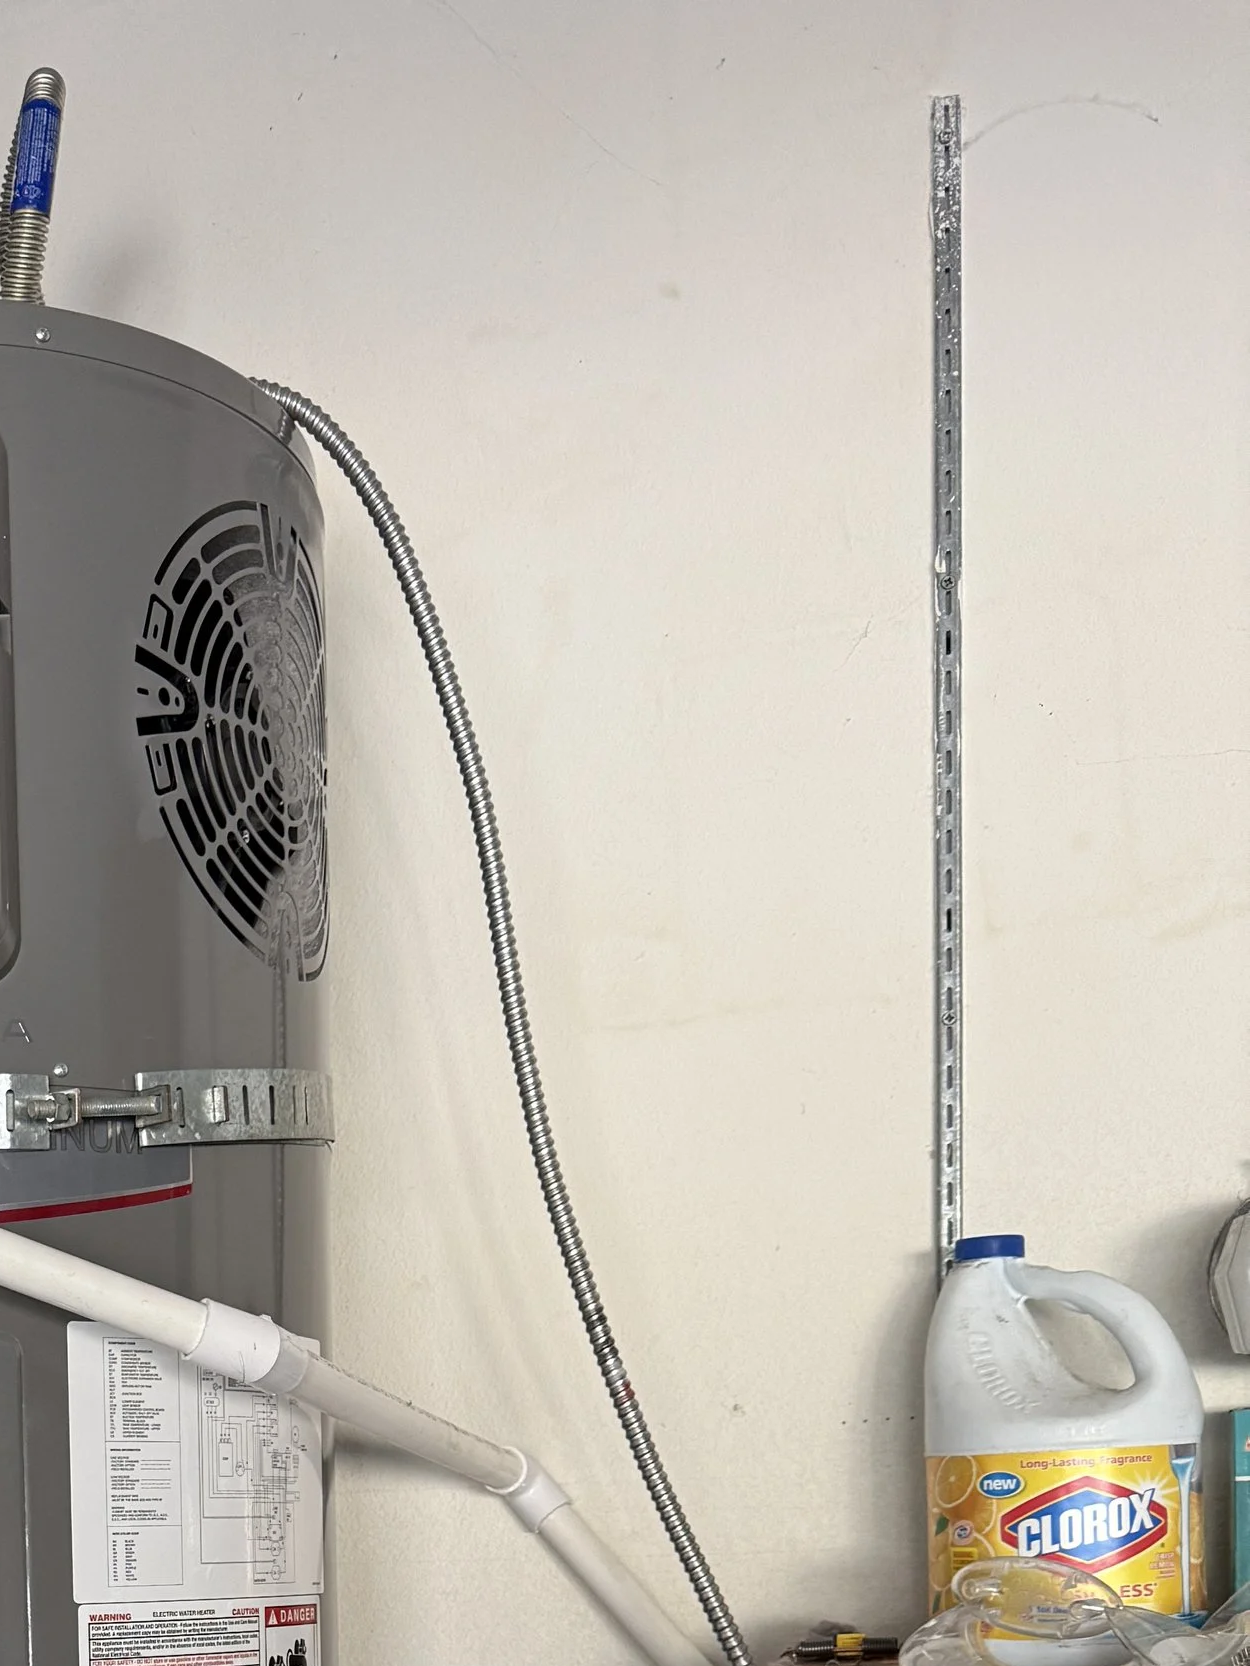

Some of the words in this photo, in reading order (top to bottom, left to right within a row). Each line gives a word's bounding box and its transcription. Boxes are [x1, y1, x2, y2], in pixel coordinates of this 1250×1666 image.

[1020, 1457, 1095, 1470] Long-Lasting
[1100, 1455, 1152, 1467] Fragrance
[983, 1478, 1017, 1490] new
[1017, 1488, 1156, 1558] CLOROX
[89, 1613, 131, 1622] WARNING
[232, 1607, 259, 1616] CAUTION
[280, 1607, 315, 1622] DANGER
